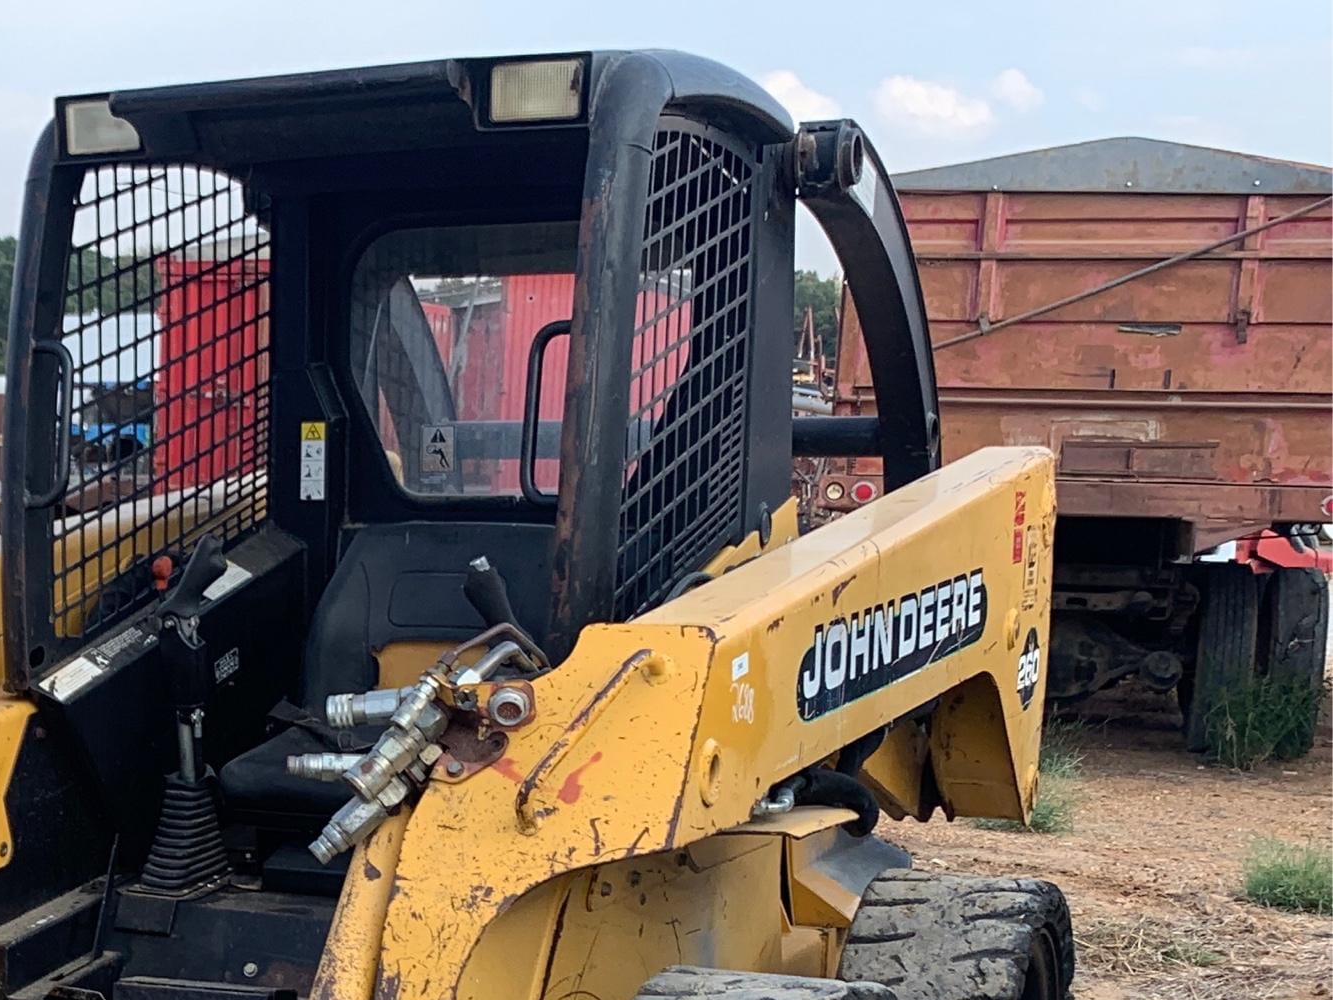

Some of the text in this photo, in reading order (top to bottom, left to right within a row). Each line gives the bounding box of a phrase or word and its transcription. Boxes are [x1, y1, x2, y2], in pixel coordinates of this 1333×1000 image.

[803, 571, 983, 699] JOHN DEERE
[1017, 648, 1040, 690] 260
